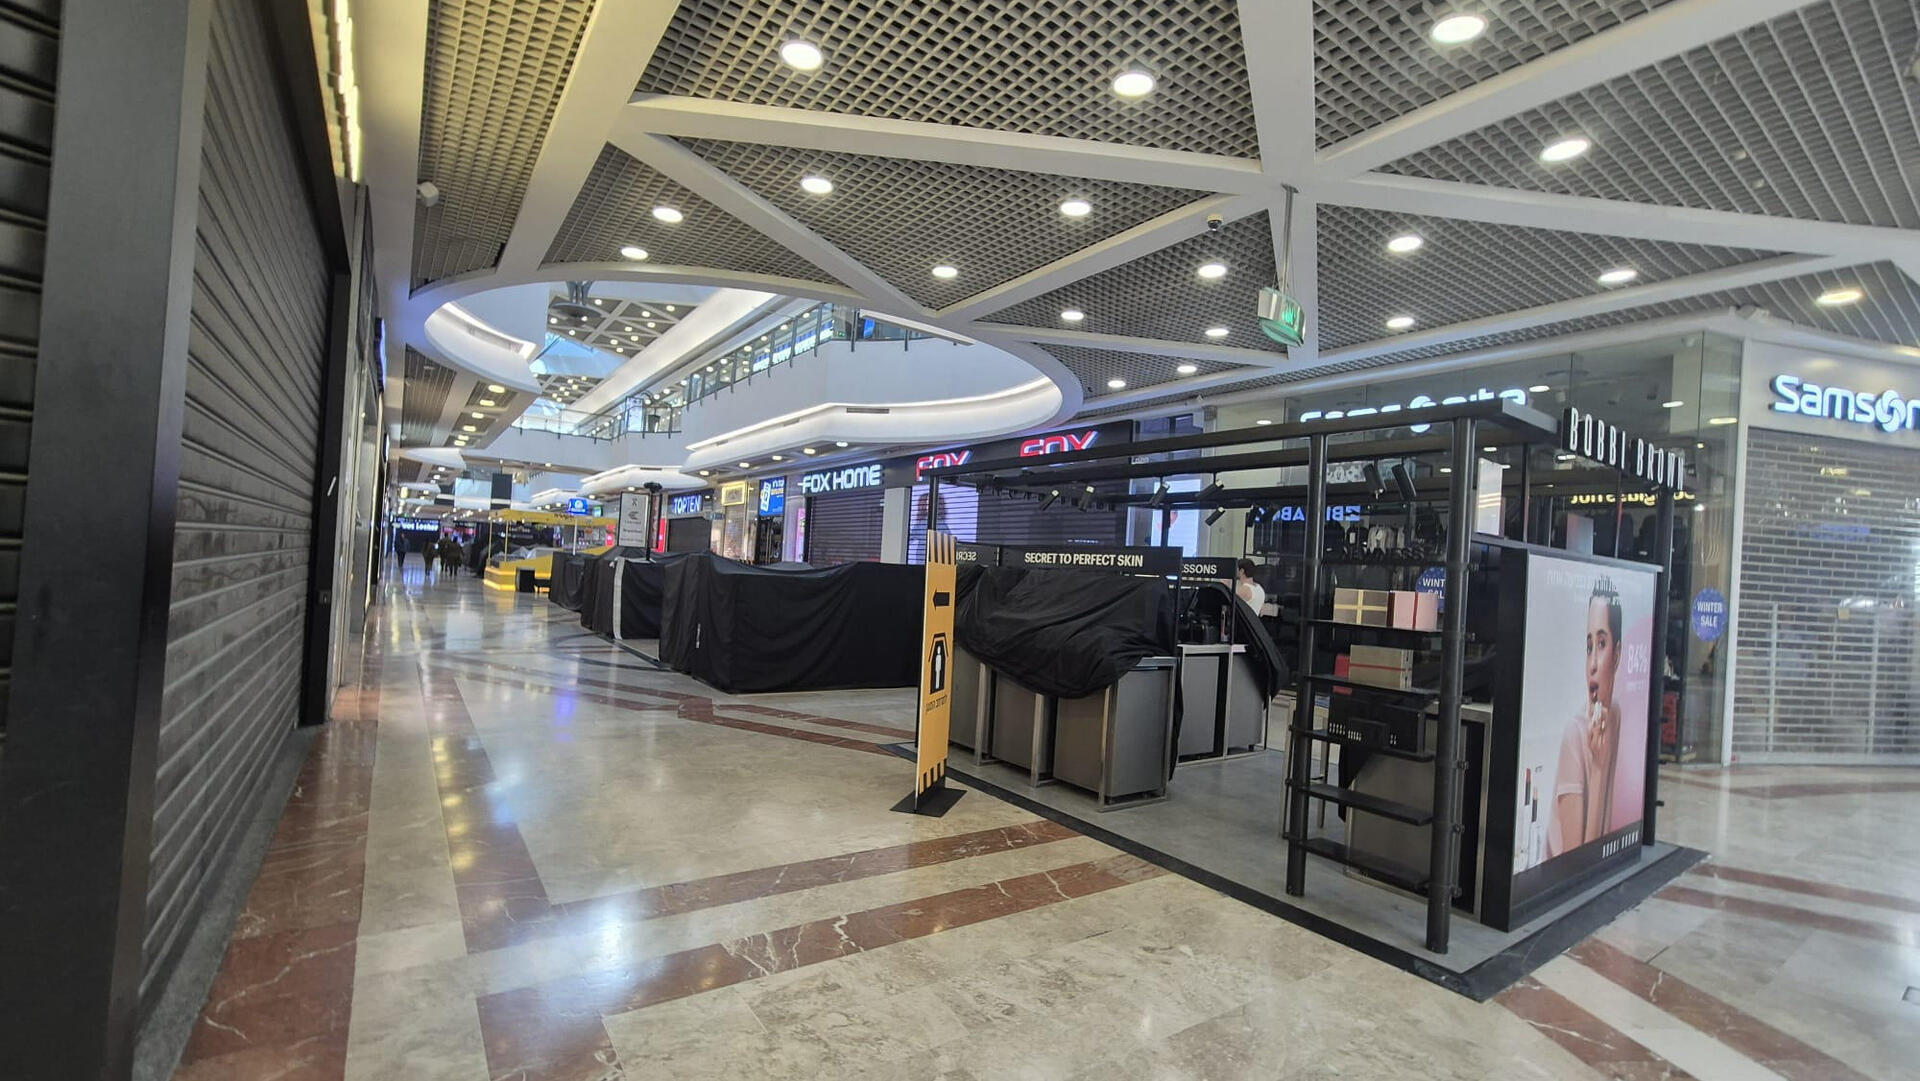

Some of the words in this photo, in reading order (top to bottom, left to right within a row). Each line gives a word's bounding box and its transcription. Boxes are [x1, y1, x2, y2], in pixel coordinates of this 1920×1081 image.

[1569, 406, 1626, 470] BOBBI
[1635, 437, 1685, 491] BROWN
[797, 472, 831, 494] FOX
[832, 464, 881, 490] HOME
[1024, 552, 1058, 564] SECRET
[1059, 553, 1072, 564] TO
[1073, 553, 1116, 566] PERFECT
[1117, 554, 1144, 567] SKIN
[1182, 563, 1217, 575] SSONS
[1696, 600, 1723, 613] WINTER
[1700, 615, 1718, 627] SALE
